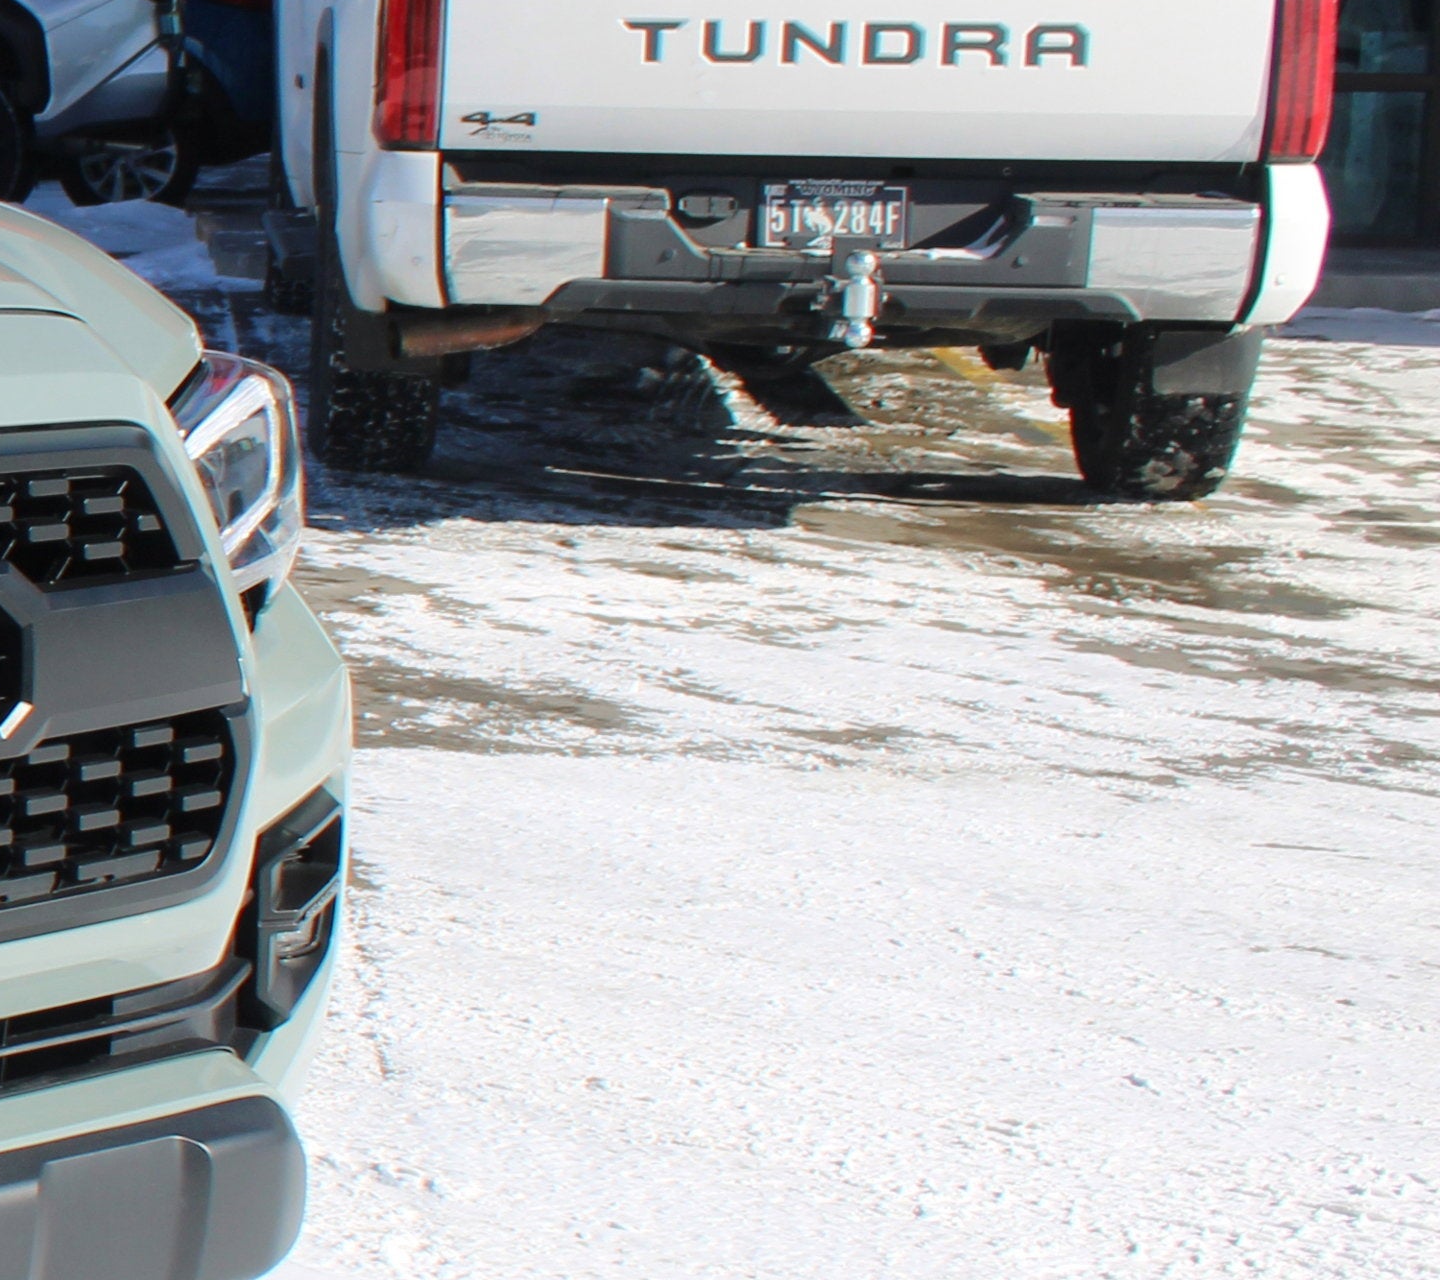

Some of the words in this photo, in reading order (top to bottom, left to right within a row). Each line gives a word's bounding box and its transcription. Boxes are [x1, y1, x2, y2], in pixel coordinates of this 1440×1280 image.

[623, 19, 1090, 66] TUNDRA
[799, 185, 877, 197] WYOMING
[833, 200, 902, 235] 284F
